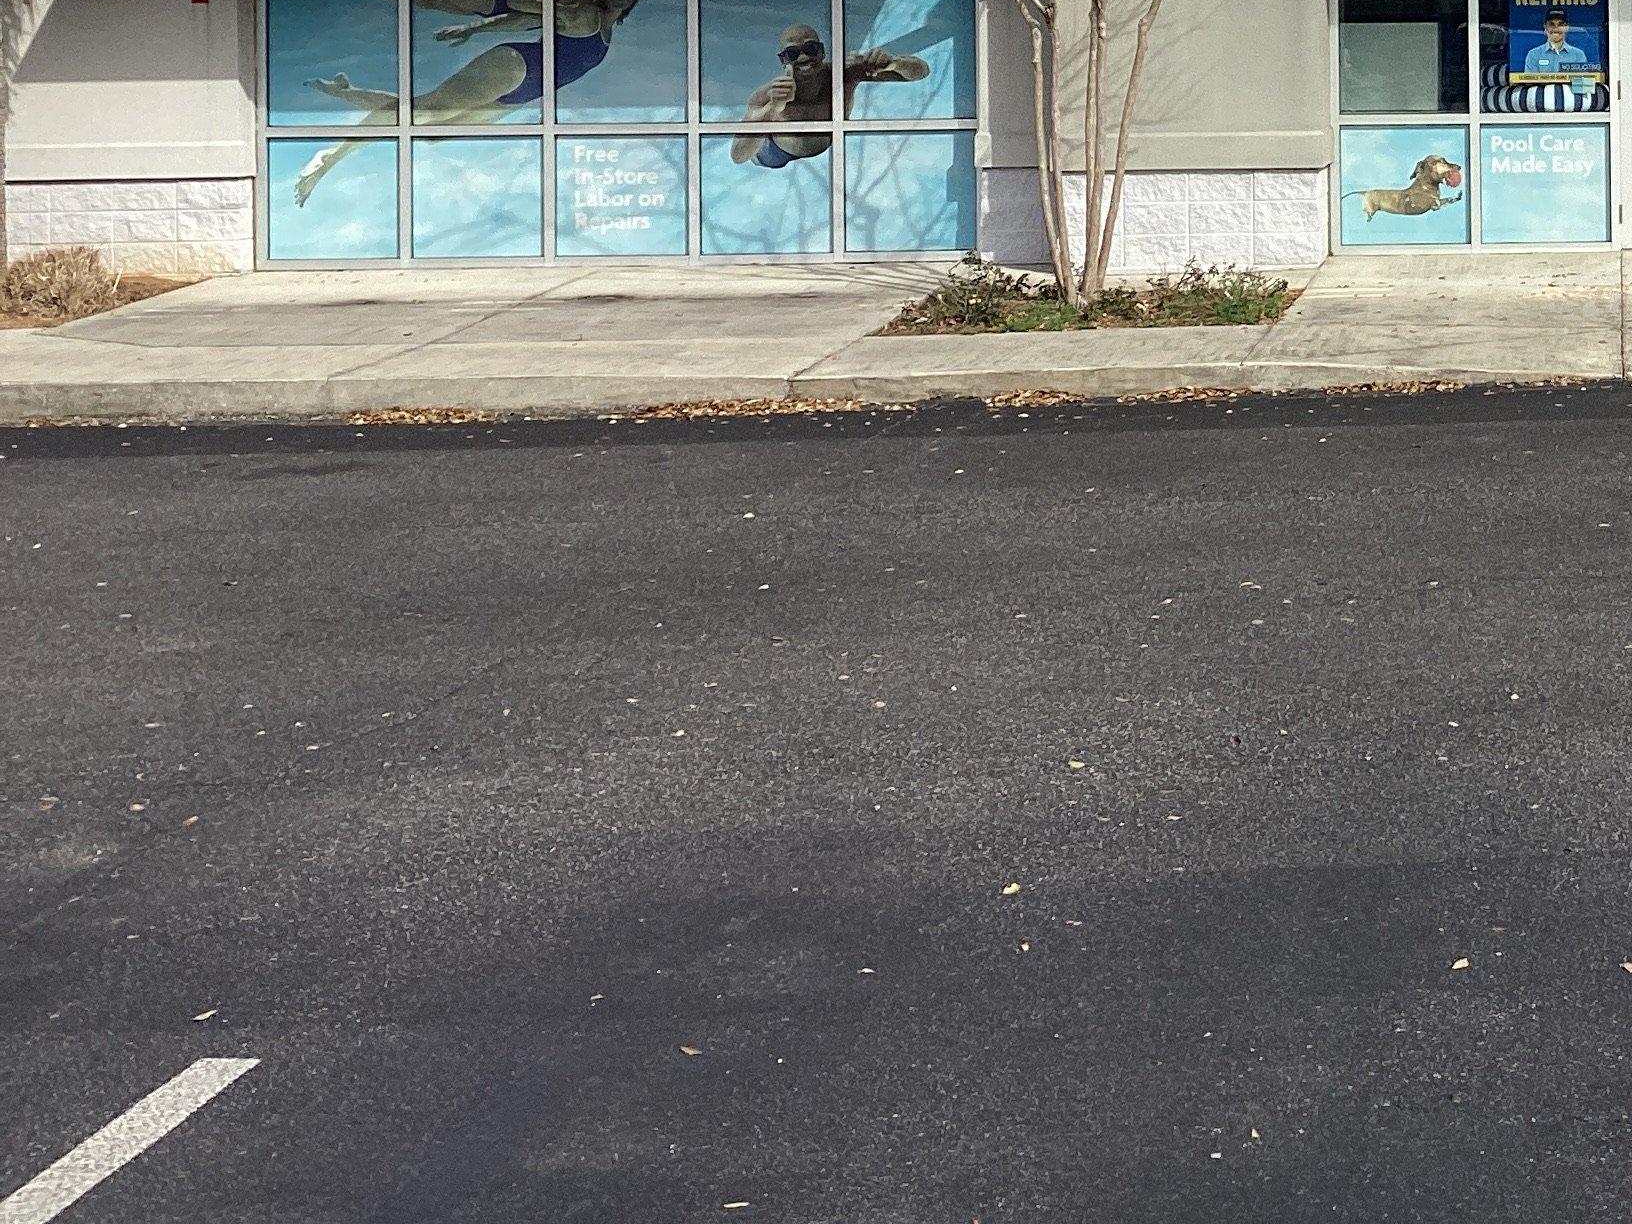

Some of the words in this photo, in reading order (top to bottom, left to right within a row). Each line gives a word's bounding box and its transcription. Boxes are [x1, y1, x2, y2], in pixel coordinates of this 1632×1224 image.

[1491, 133, 1534, 153] Pool
[1539, 134, 1585, 152] Care
[574, 144, 619, 163] Free
[1491, 154, 1547, 173] Made
[1552, 155, 1595, 177] Easy
[574, 167, 659, 185] In-Store
[574, 187, 634, 207] Labor
[637, 193, 664, 207] on
[574, 212, 651, 235] Repairs
